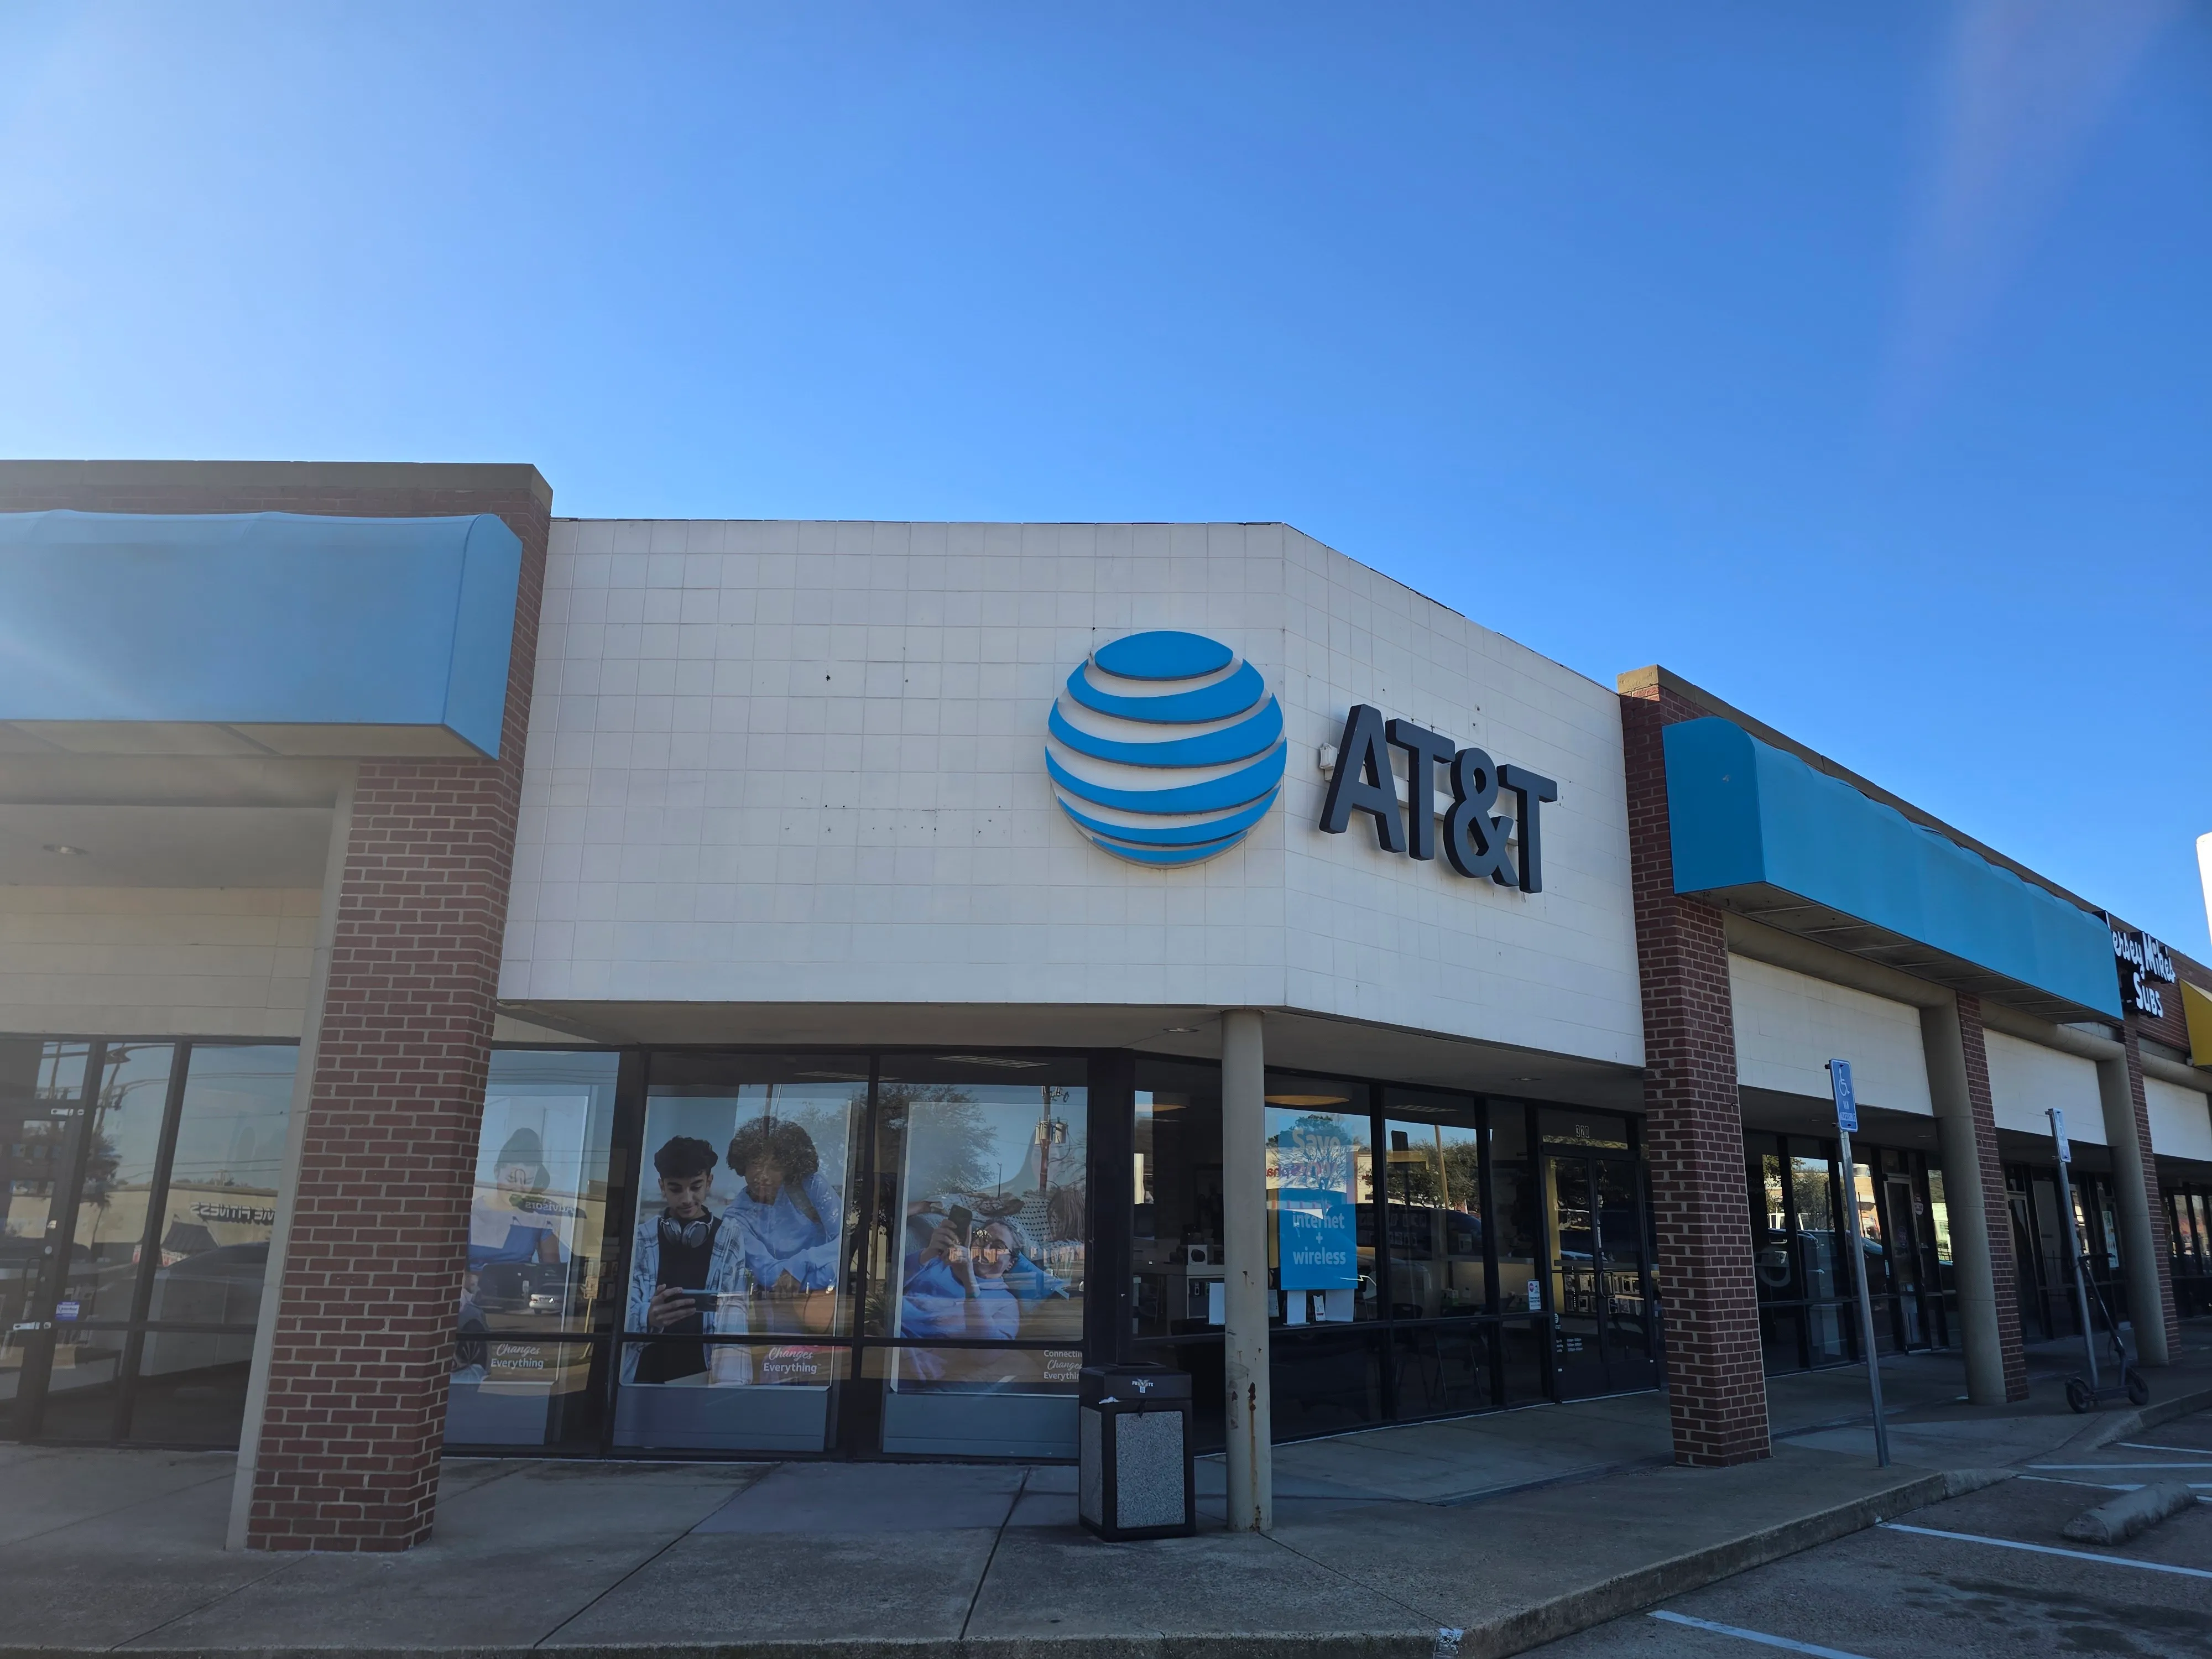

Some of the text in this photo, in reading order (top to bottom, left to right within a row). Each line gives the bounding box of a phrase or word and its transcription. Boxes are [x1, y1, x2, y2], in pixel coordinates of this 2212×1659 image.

[1318, 704, 1558, 894] AT&T
[2105, 911, 2176, 983] ersey Mike's
[1292, 1128, 1341, 1157] Save
[1292, 1211, 1345, 1229] internet
[1292, 1246, 1347, 1265] wireless
[496, 1343, 541, 1357] Changes
[768, 1347, 814, 1361] Changes
[491, 1358, 544, 1370] Everything
[763, 1362, 818, 1375] Everything
